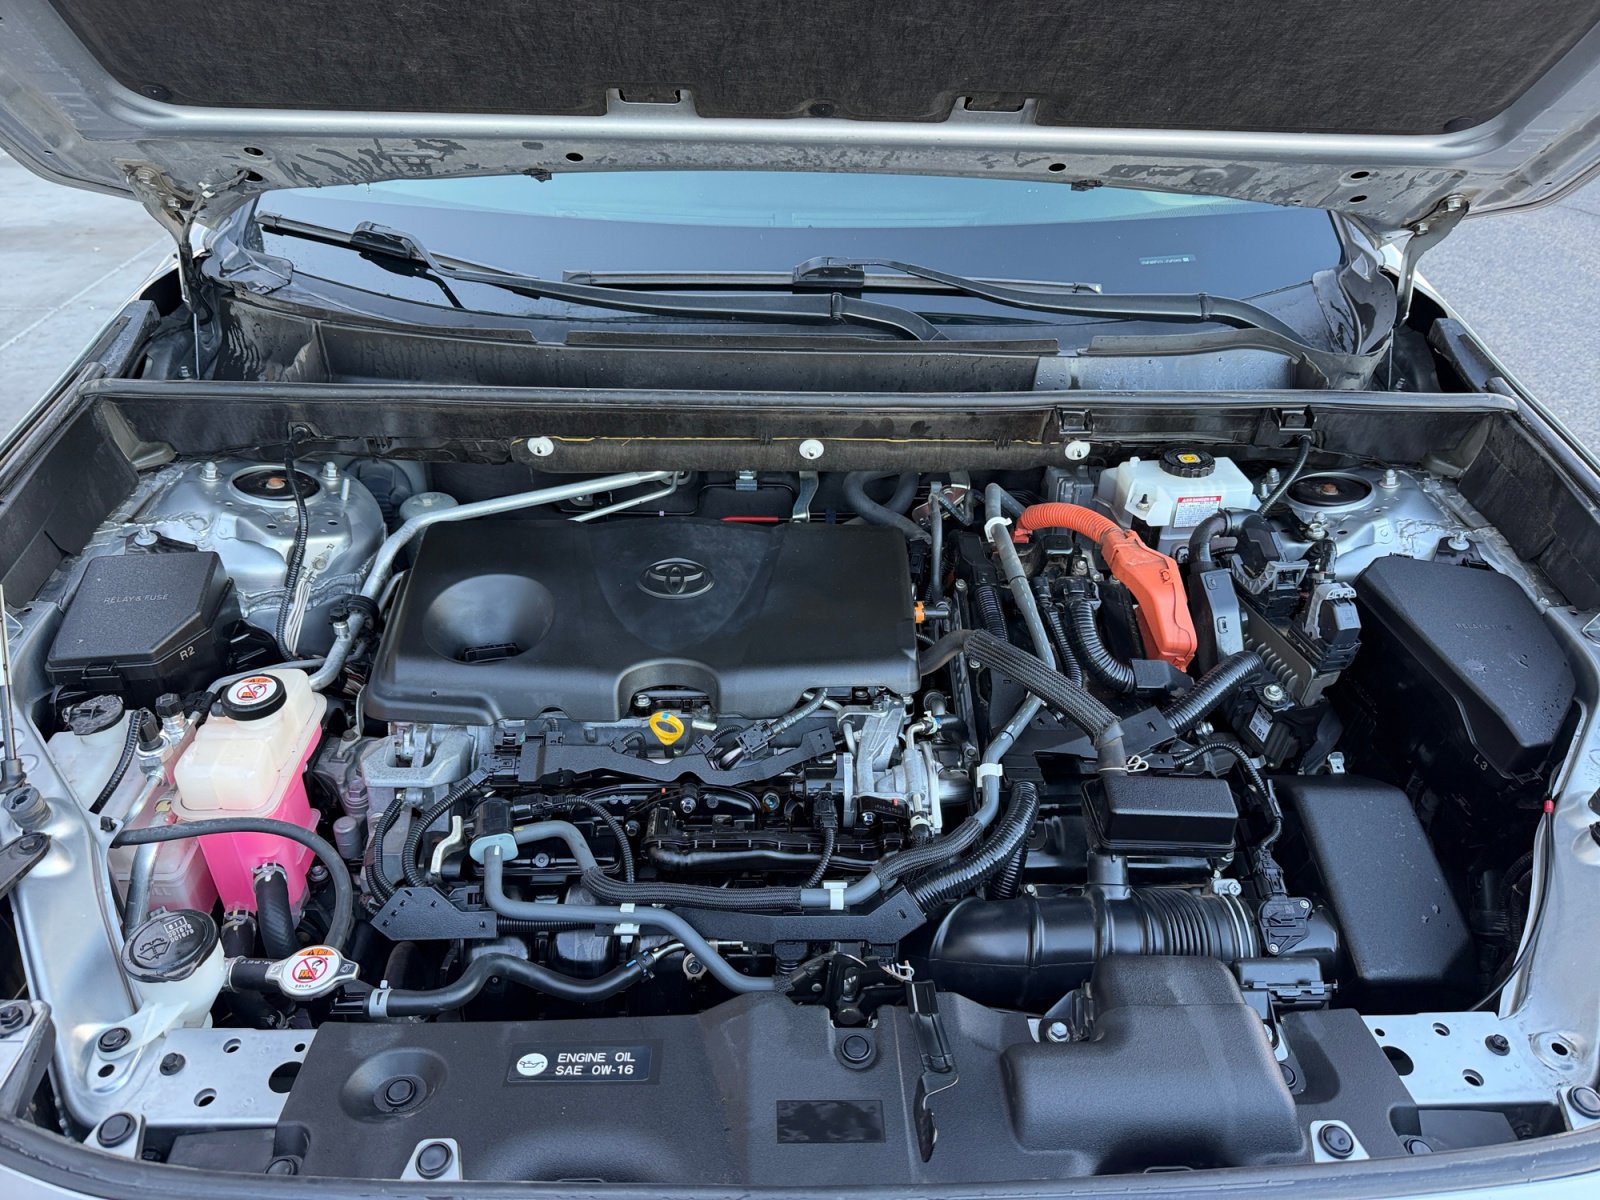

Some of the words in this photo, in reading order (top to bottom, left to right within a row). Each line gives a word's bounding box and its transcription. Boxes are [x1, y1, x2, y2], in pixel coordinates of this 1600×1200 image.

[144, 593, 169, 601] FUSE
[180, 645, 195, 661] R2
[1256, 728, 1265, 739] B1
[1473, 753, 1488, 771] L3
[557, 1052, 607, 1063] ENGINE
[614, 1052, 635, 1062] OIL
[555, 1065, 583, 1076] SAE
[591, 1064, 635, 1075] 0W-16
